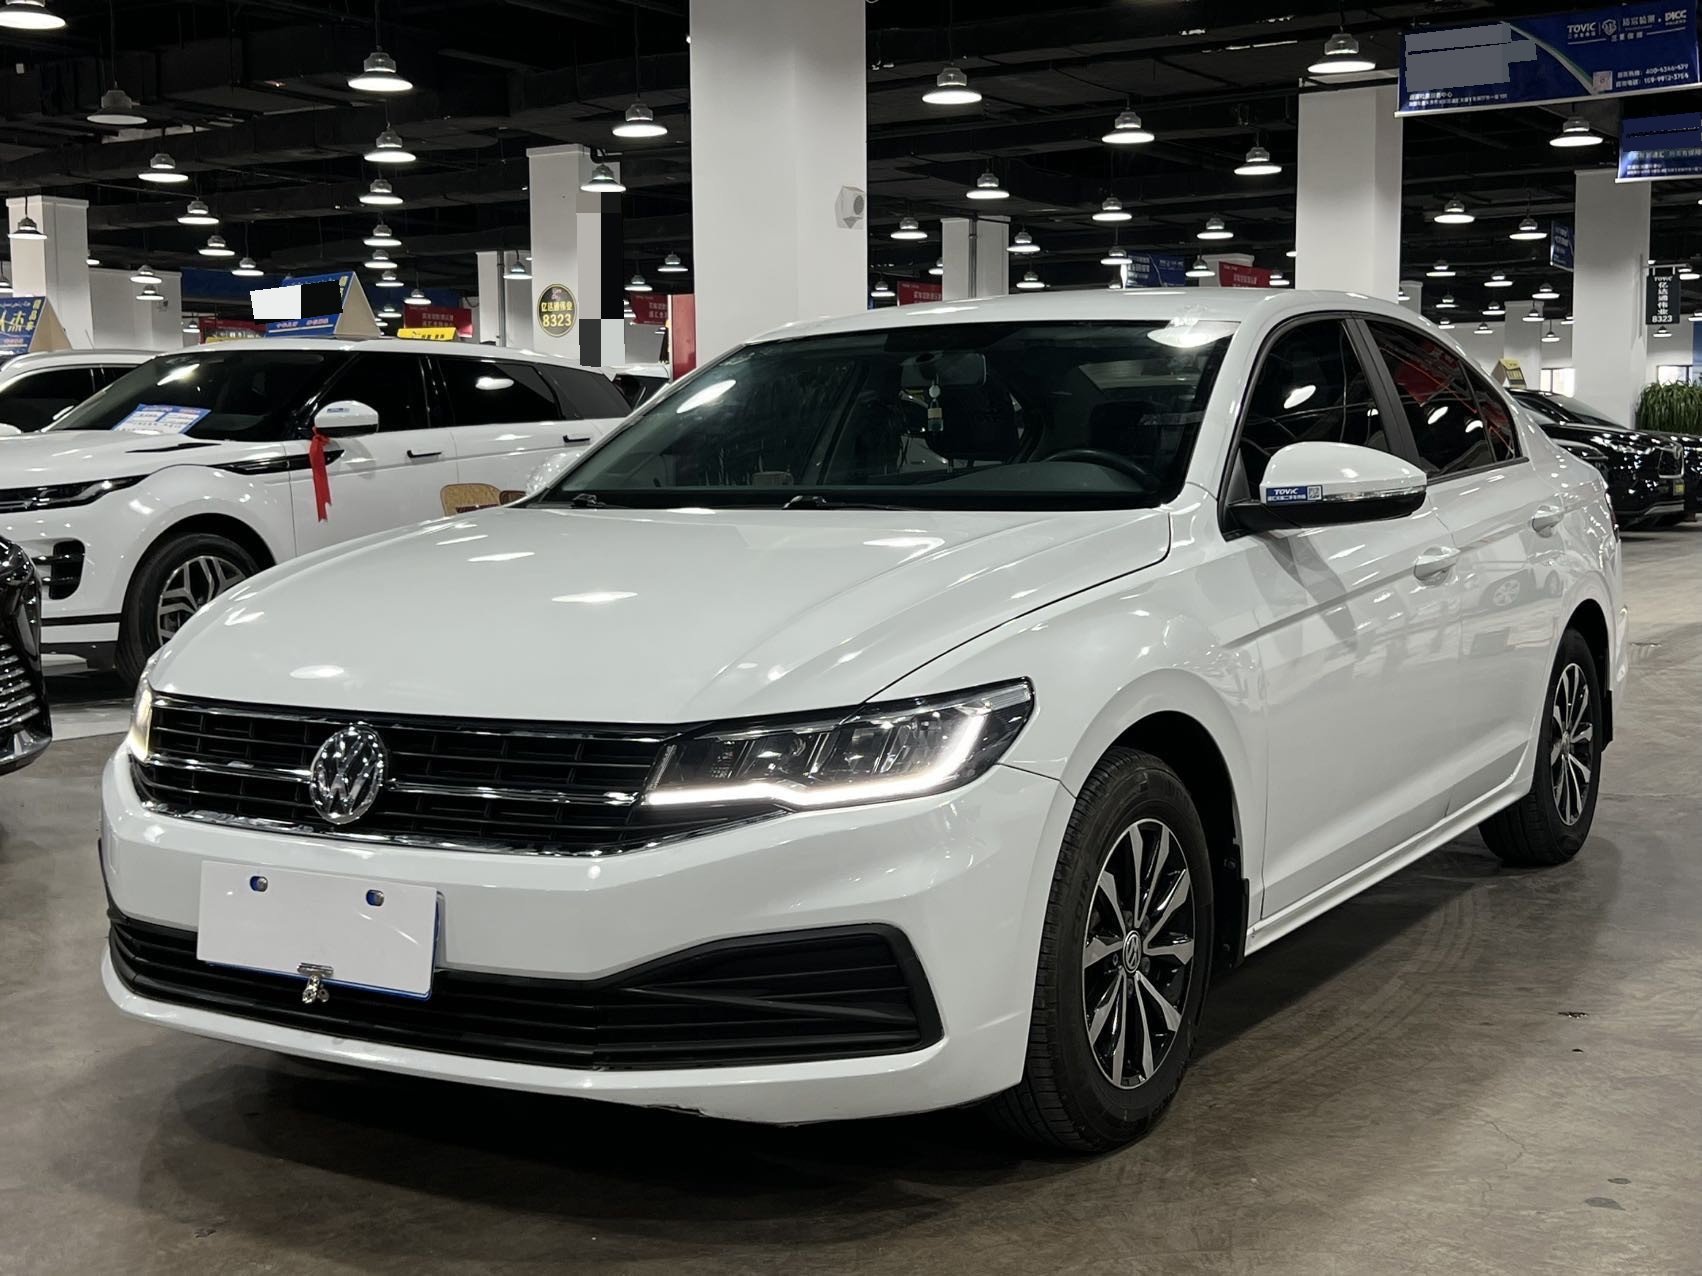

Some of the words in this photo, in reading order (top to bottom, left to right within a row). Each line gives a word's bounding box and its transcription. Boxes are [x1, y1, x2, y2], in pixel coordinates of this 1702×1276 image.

[1567, 23, 1596, 33] TOVIC
[542, 314, 572, 327] 8323
[1652, 315, 1673, 323] 8323
